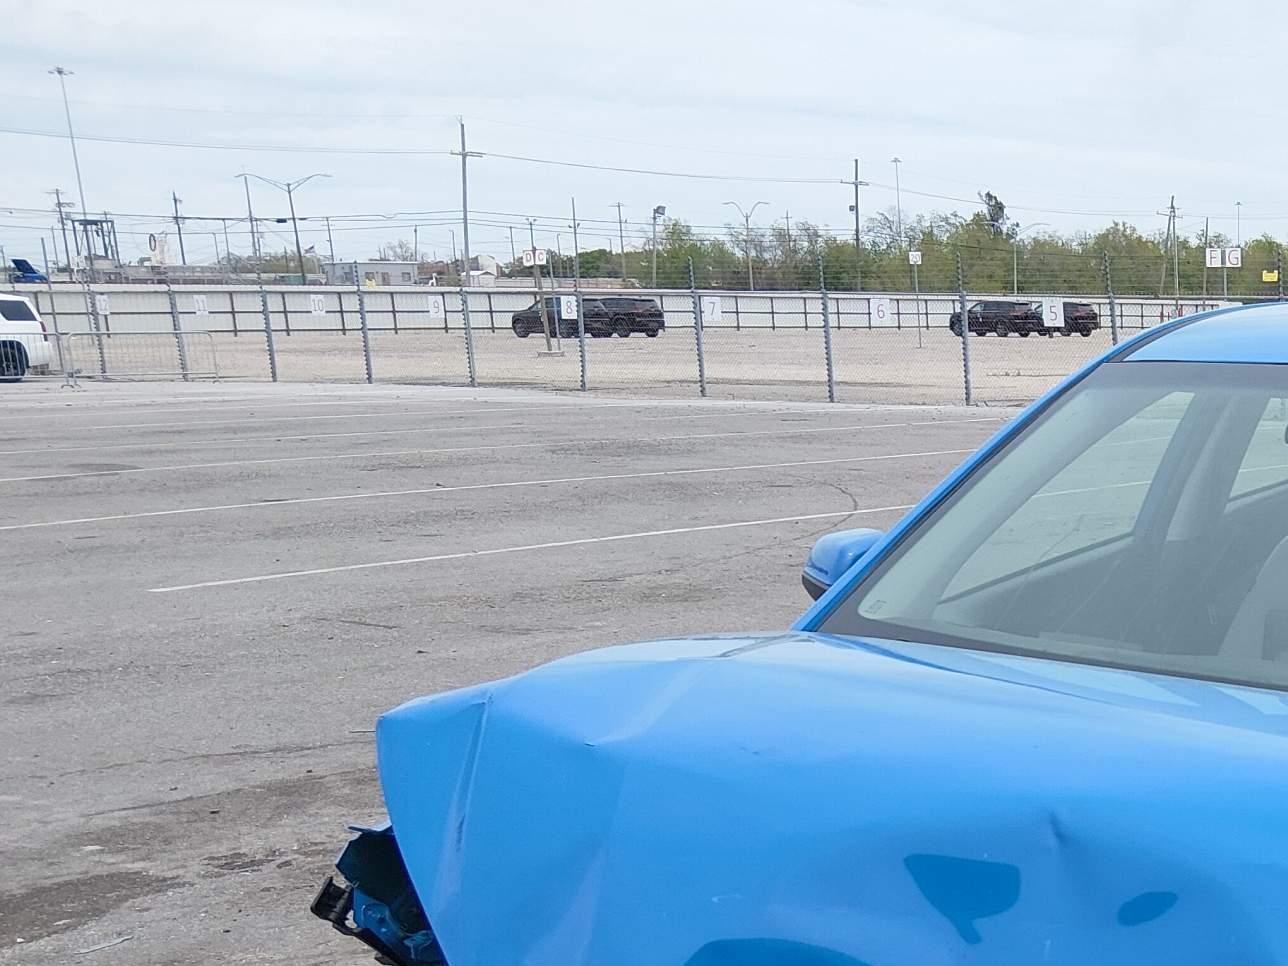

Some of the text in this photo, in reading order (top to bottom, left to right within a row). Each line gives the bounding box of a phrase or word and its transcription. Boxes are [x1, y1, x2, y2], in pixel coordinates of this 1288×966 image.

[524, 252, 533, 264] D
[537, 251, 546, 263] C
[1209, 249, 1218, 266] F
[1227, 249, 1240, 266] G
[311, 298, 325, 312] 10
[432, 300, 441, 314] 9
[565, 300, 574, 315] 8
[709, 301, 717, 316] 7
[876, 303, 886, 319] 6
[1049, 307, 1058, 321] 5
